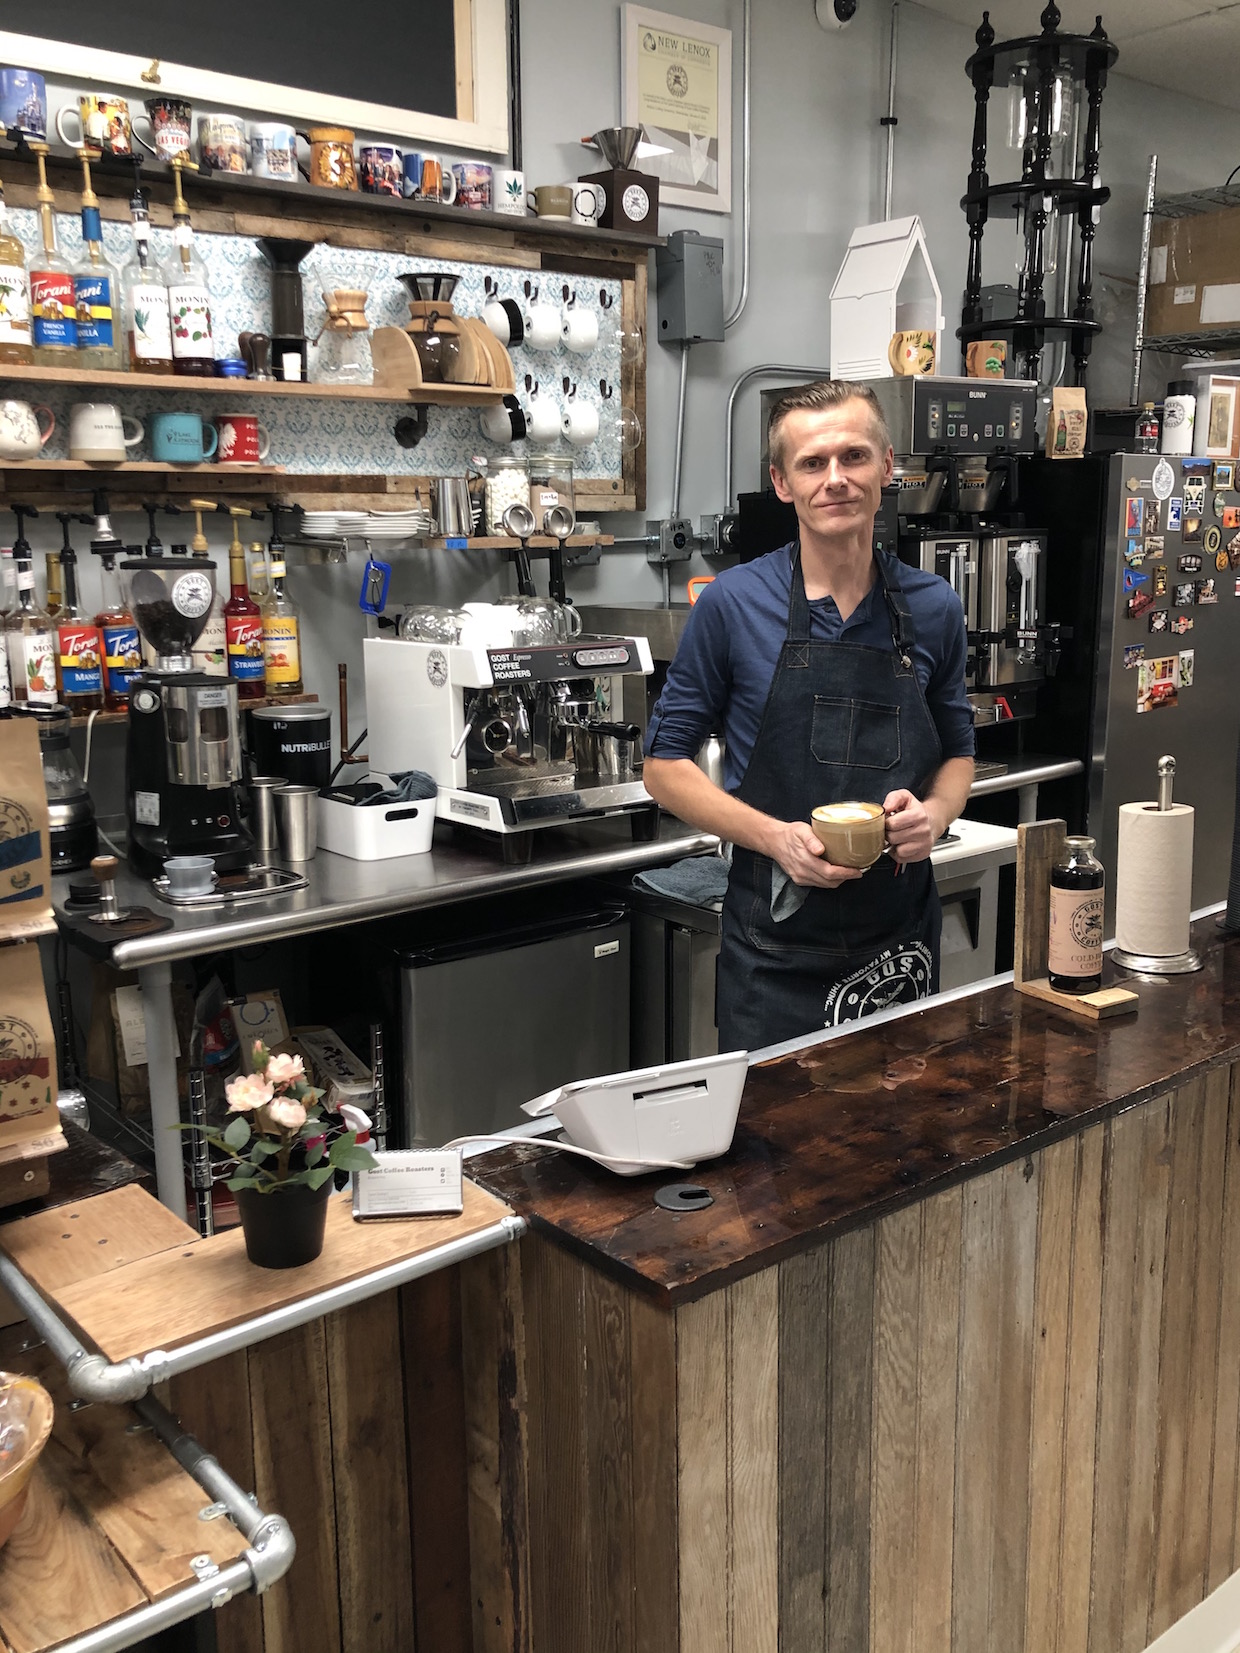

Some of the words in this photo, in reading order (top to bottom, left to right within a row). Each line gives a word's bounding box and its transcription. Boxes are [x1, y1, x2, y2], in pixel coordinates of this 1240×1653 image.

[658, 36, 679, 50] NEW
[682, 42, 711, 58] LENOX
[0, 276, 24, 285] MON
[32, 280, 72, 304] Torani
[75, 282, 103, 300] rani
[43, 322, 65, 330] FRENCH
[43, 329, 66, 337] VANILLA
[969, 390, 987, 399] BUNN
[232, 624, 264, 646] Toran
[33, 645, 54, 653] MON
[63, 633, 99, 657] Toran
[108, 633, 138, 657] Tora
[490, 654, 510, 662] GOST
[492, 663, 521, 671] COFFEE
[494, 670, 532, 680] ROASTERS
[281, 741, 331, 753] NUTRiBULLE
[879, 949, 892, 962] MY
[1071, 953, 1094, 963] COLD
[841, 958, 880, 984] FAVORITE
[865, 956, 914, 986] GOS
